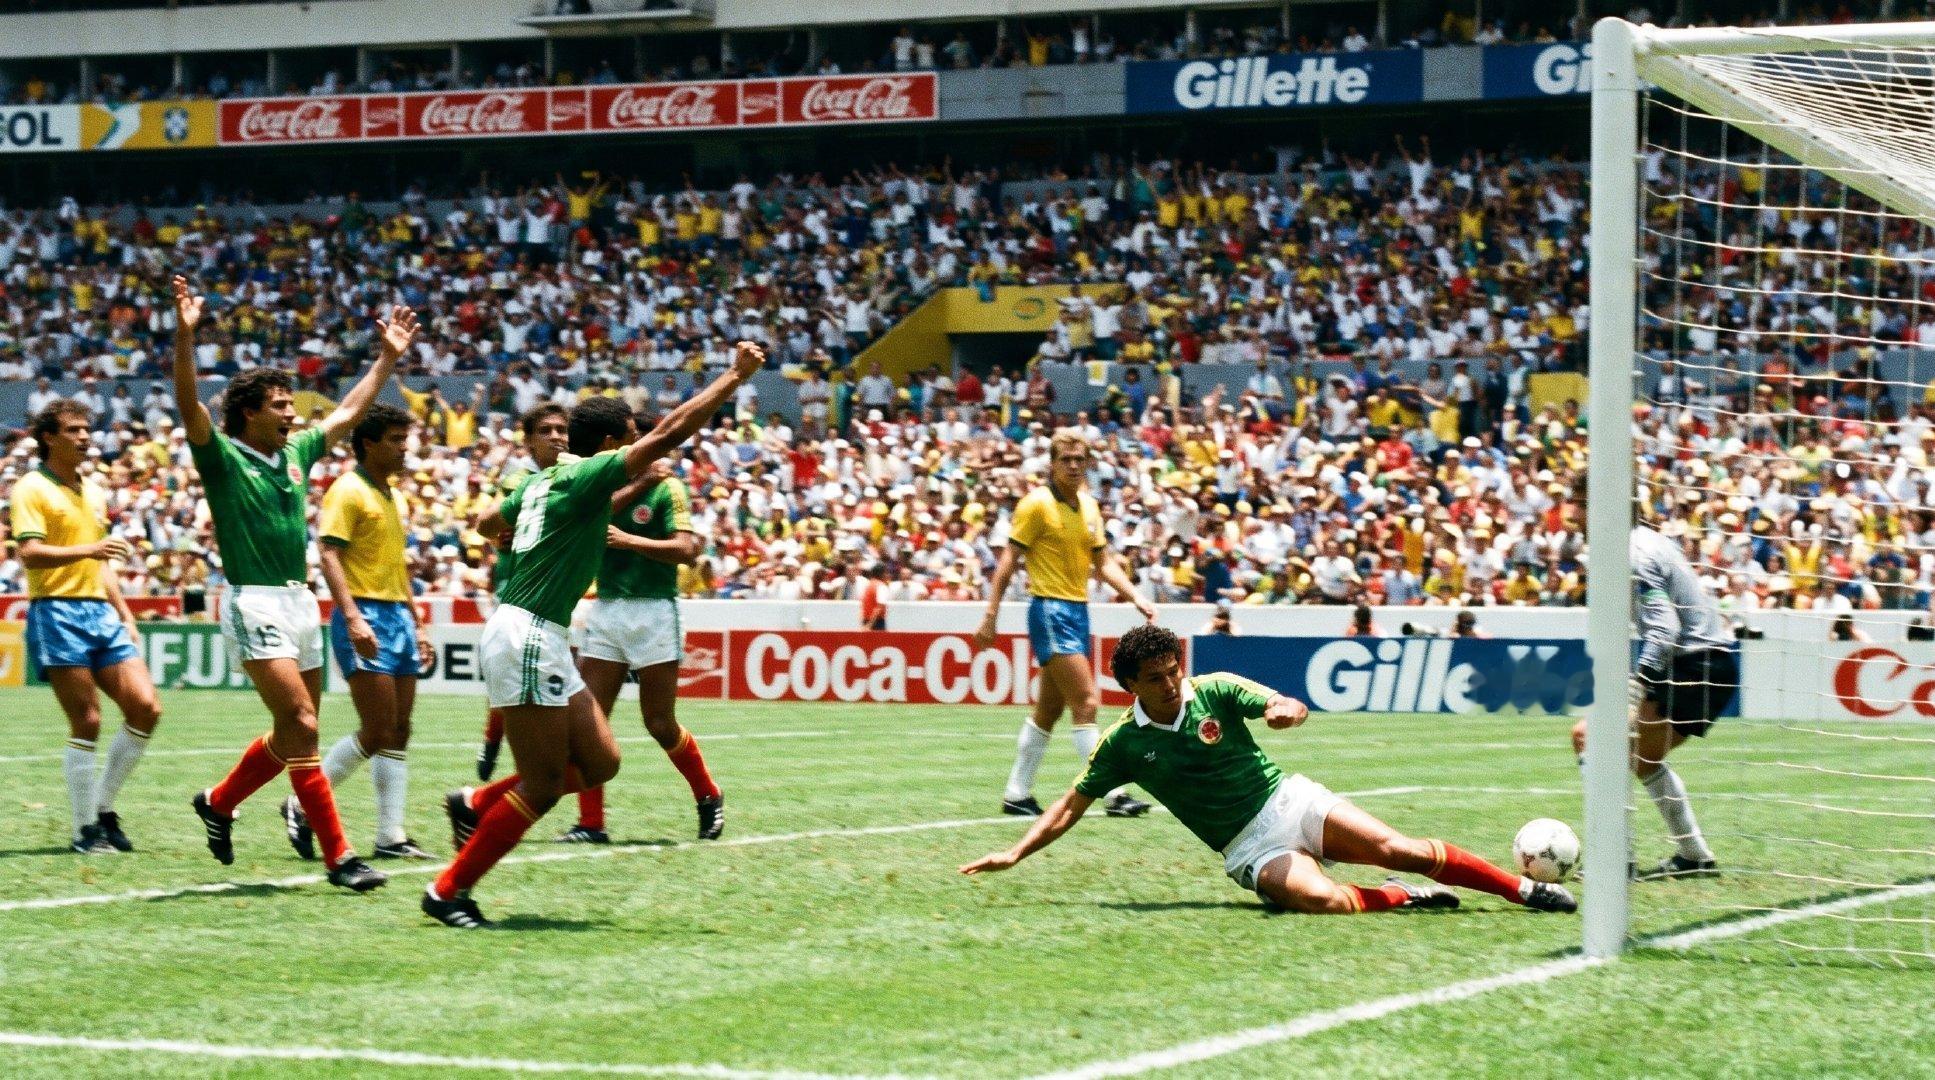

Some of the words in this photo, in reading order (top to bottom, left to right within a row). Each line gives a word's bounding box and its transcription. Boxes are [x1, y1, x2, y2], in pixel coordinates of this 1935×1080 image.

[1174, 57, 1370, 109] Gillette
[0, 111, 63, 146] OL
[745, 632, 1041, 704] Coca-Col
